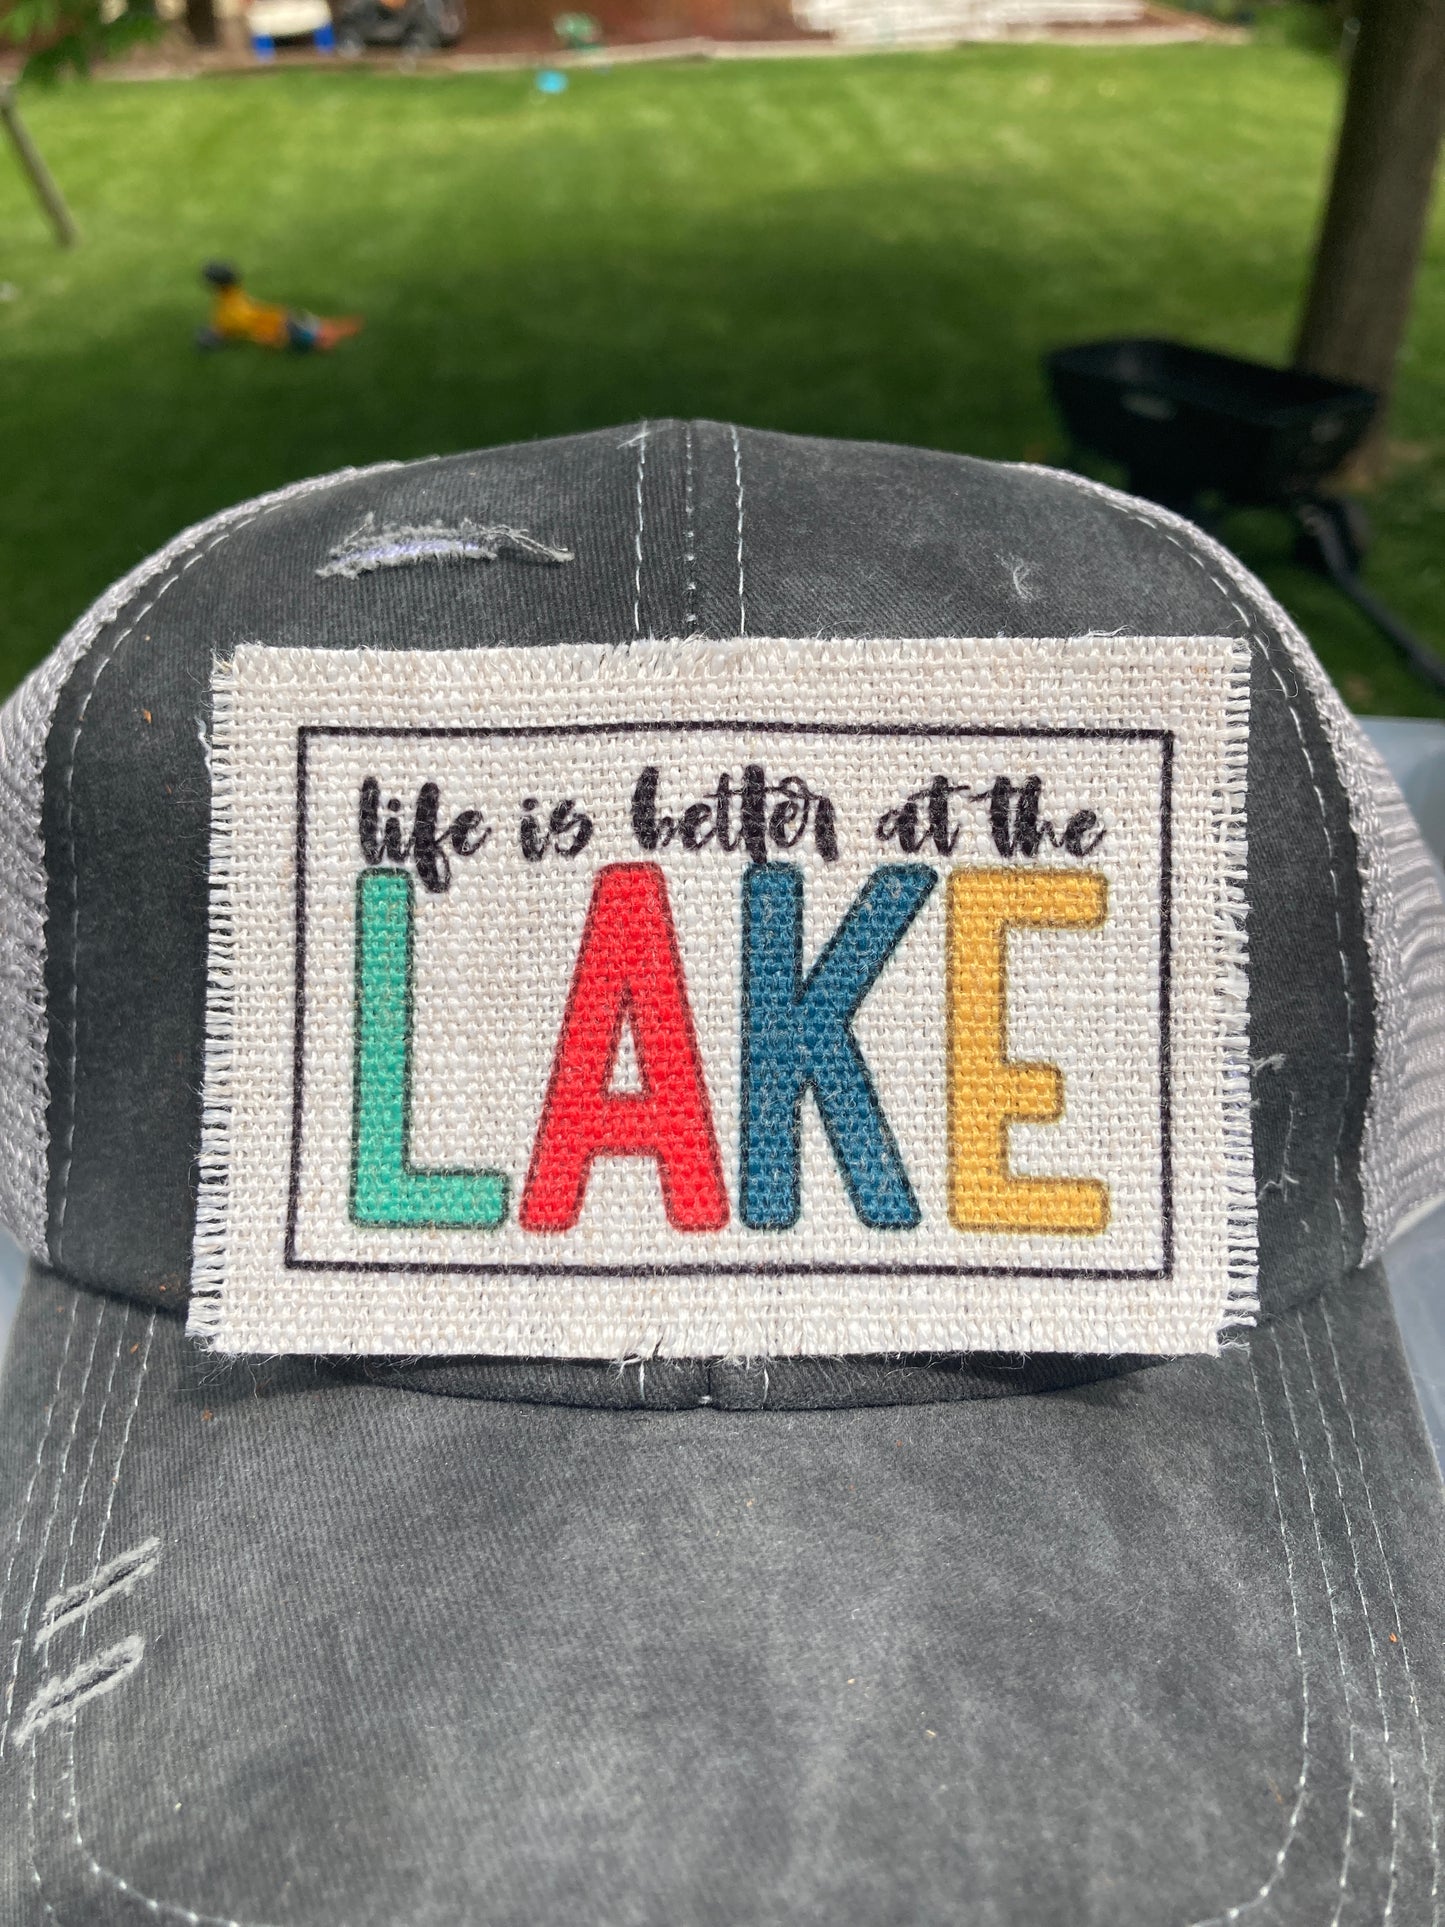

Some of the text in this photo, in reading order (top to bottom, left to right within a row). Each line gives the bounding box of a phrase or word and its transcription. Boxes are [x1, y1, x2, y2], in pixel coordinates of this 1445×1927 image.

[358, 764, 1107, 894] life is better at the
[348, 861, 1110, 1234] LAKE
